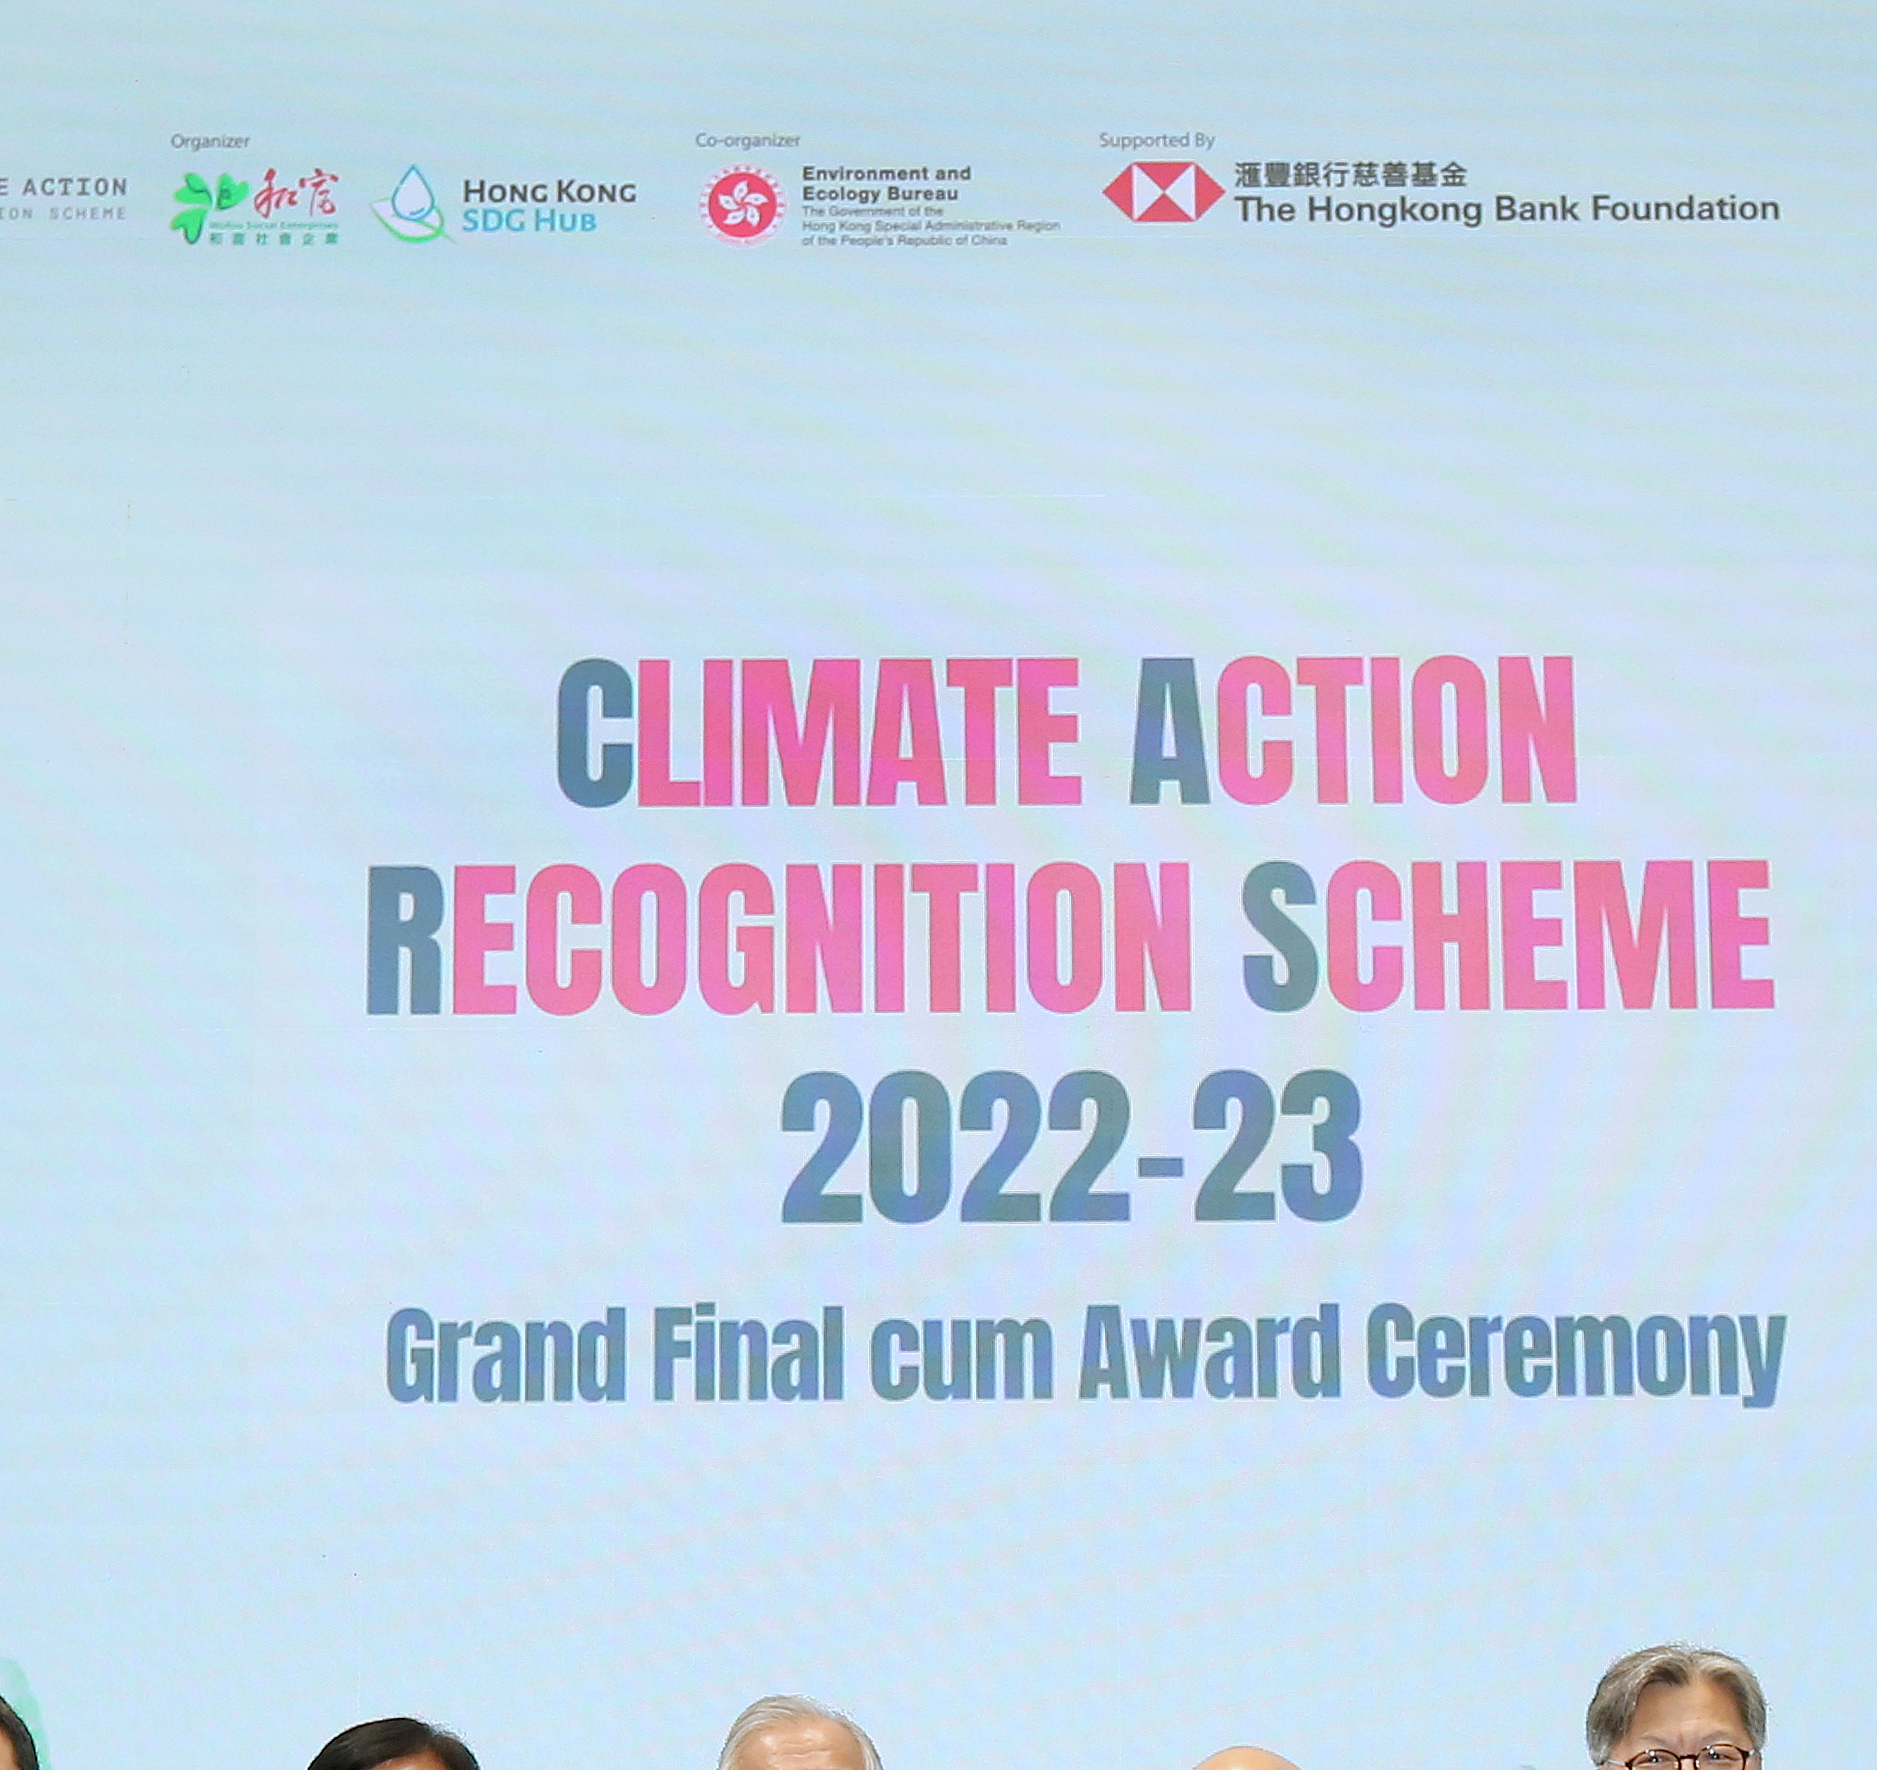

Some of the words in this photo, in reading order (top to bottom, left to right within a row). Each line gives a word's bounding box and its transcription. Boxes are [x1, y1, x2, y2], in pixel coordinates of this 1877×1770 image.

[170, 133, 251, 152] Organizer
[695, 132, 801, 151] Co-organizer
[1099, 132, 1193, 151] Supported
[1195, 132, 1216, 151] By
[802, 165, 928, 181] Environment
[935, 165, 971, 181] and
[22, 177, 128, 197] ACTION
[464, 179, 548, 203] HONG
[557, 179, 636, 203] KONG
[802, 185, 881, 204] Ecology
[887, 185, 958, 201] Bureau
[49, 206, 126, 221] SCHEME
[462, 208, 525, 232] SDG
[534, 208, 597, 232] HUB
[802, 206, 824, 217] The
[829, 206, 905, 217] Government
[908, 206, 921, 217] of
[923, 206, 943, 217] the
[1234, 195, 1296, 222] The
[1308, 195, 1482, 229] Hongkong
[1495, 195, 1580, 221] Bank
[1592, 194, 1779, 221] Foundation
[802, 221, 835, 233] Hong
[839, 221, 871, 233] Kong
[874, 221, 922, 233] Special
[925, 221, 1013, 233] Administrative
[1017, 221, 1061, 233] Region
[802, 235, 815, 246] of
[817, 235, 837, 246] the
[840, 235, 894, 248] People's
[897, 235, 952, 248] Republic
[955, 235, 969, 246] of
[971, 235, 1008, 246] China
[556, 656, 1083, 809] CLIMATE
[1129, 655, 1578, 806] ACTION
[366, 860, 1192, 1017] RECOGNITION
[1241, 859, 1776, 1014] SCHEME
[781, 1068, 1364, 1224] 2022-23
[386, 1305, 627, 1403] Grand
[653, 1302, 845, 1402] Final
[870, 1317, 1053, 1401] cum
[1078, 1302, 1342, 1400] Award
[1367, 1301, 1788, 1410] Ceremony
